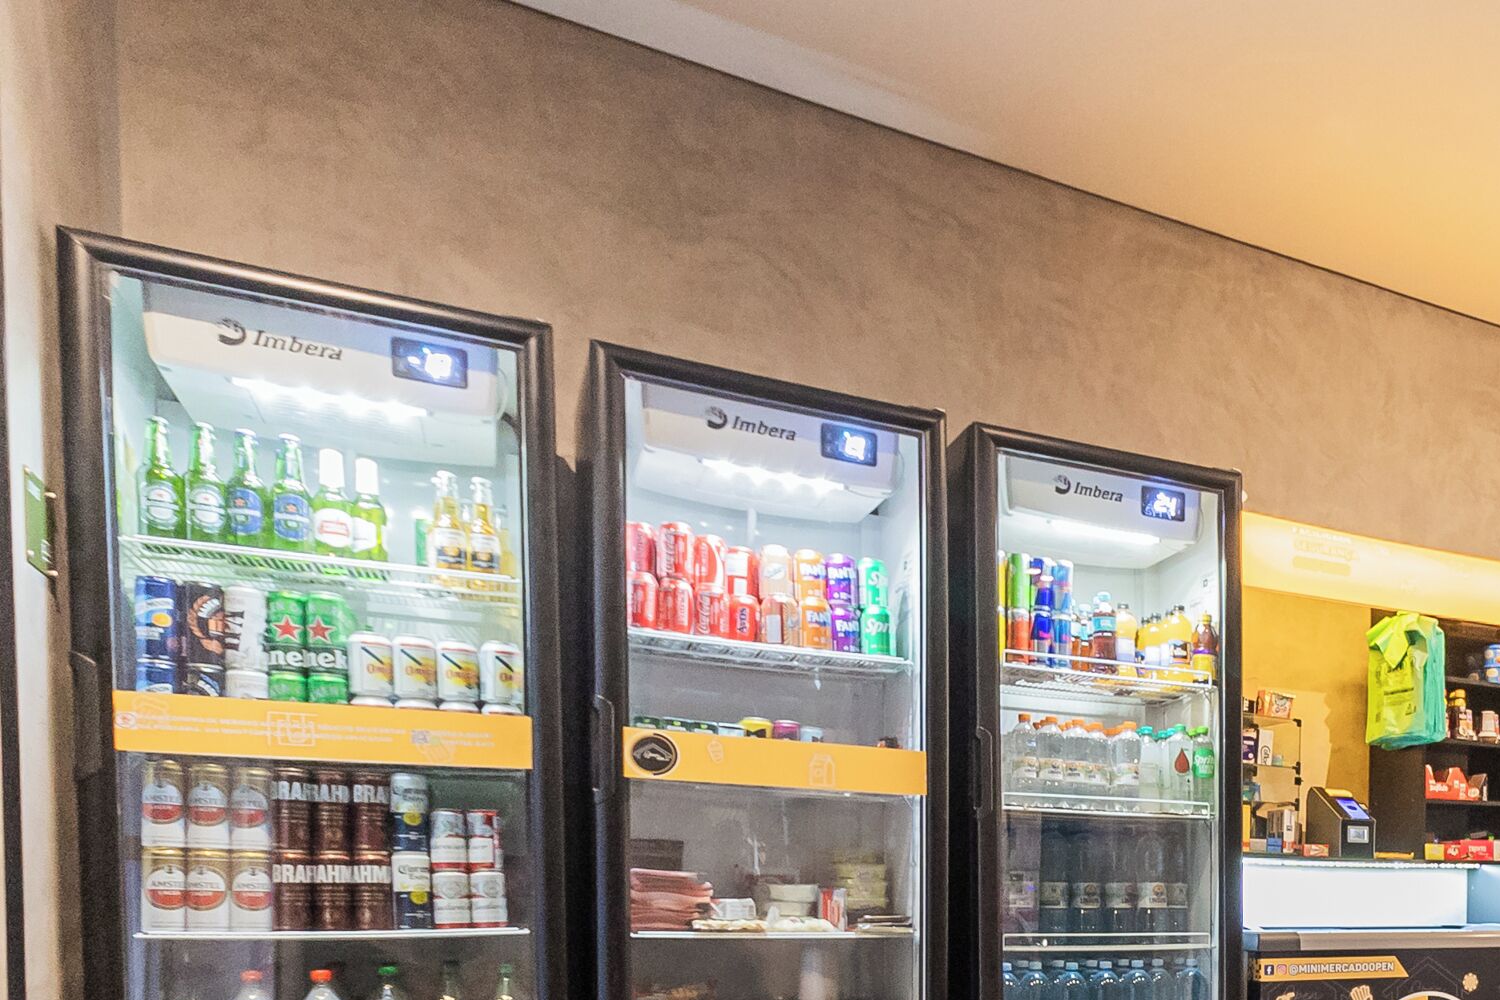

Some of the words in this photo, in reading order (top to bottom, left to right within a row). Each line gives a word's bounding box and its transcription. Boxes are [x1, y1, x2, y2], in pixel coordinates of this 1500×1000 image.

[252, 329, 343, 361] Imbera
[732, 415, 798, 441] Imbera
[1073, 481, 1124, 503] Imbera
[1289, 962, 1394, 977] @MINIMERCADOOPEN
